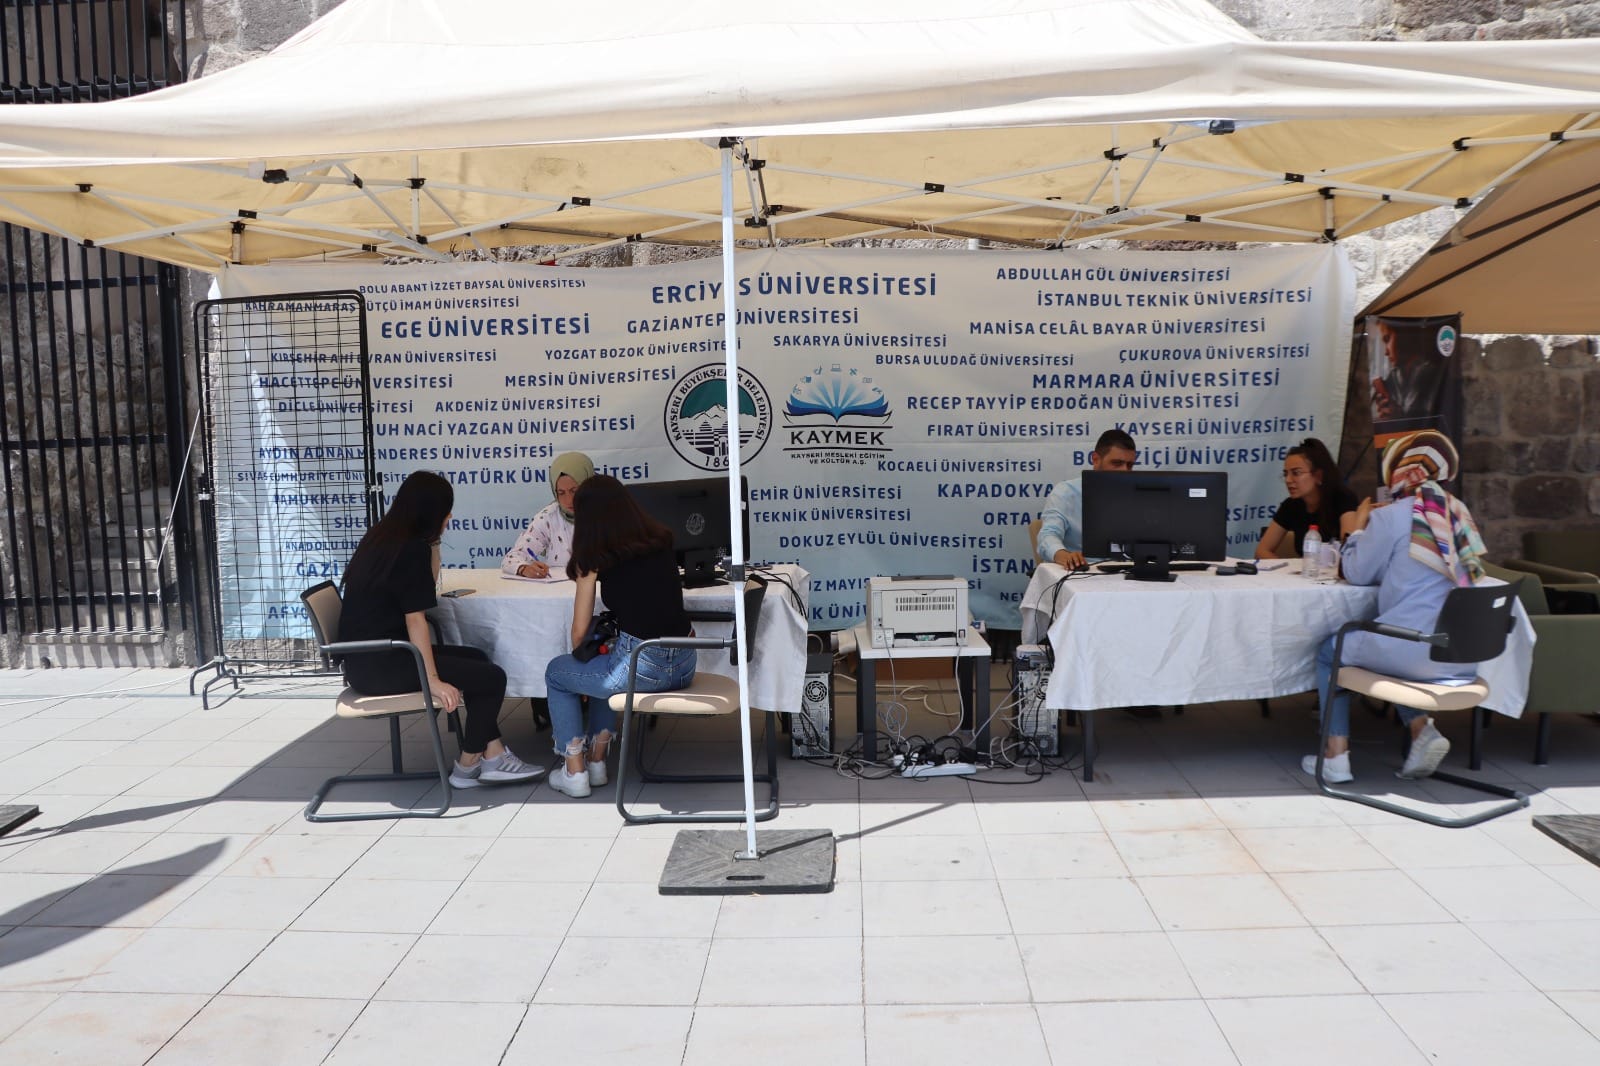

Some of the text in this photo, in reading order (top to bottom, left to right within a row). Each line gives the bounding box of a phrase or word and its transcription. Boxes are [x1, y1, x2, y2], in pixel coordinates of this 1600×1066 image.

[997, 267, 1230, 282] ABDULLAH GÜL ÜNİVERSİTESİ
[359, 278, 586, 294] BOLU ABANT İZZET BAYSAL ÜNİVERSİTESİ
[652, 271, 936, 304] ERCİYS ÜNİVERSİTESİ
[366, 301, 397, 313] ÜTÇÜ
[400, 300, 431, 310] İMAM
[435, 296, 519, 309] ÜNİVERSİTESİ
[1037, 287, 1312, 306] İSTANBUL TEKNİK ÜNİVERSİTESİ
[382, 313, 590, 338] EGE ÜNİVERSİTESİ
[627, 312, 726, 334] GAZİANTEP
[970, 318, 1266, 335] MANİSA CELÂL BAYAR ÜNİVERSİTESİ
[773, 332, 947, 347] SAKARYA ÜNİVERSİTESİ
[405, 349, 497, 363] ÜNİVERSİTESİ
[545, 337, 741, 361] YOZGAT BOZOK ÜNİVERSİTEİ
[1119, 344, 1310, 363] ÇUKUROVA ÜNİVERSİTESİ
[876, 353, 1074, 366] BURSA ULUDAĞ ÜNİVERSİTESİ
[260, 374, 453, 388] HACETTEPE ÜNVERSİTESİ
[505, 365, 676, 387] MERSİN ÜNİVERSİTESİ
[680, 368, 743, 395] BÜYÜKŞER
[1032, 368, 1280, 388] MARMARA ÜNİVERSİTESİ
[435, 395, 600, 412] AKDENİZ ÜNİVERSİTESİ
[907, 392, 1239, 410] RECEP TAYYİP ERDOĞAN ÜNİVERSİTESİ
[373, 415, 635, 436] UH NACİ YAZGAN ÜNİVERSİTESİ
[927, 421, 1090, 436] FIRAT ÜNİVERSİTESİ
[1198, 415, 1314, 434] ÜNİVERSİTESİ
[791, 431, 884, 445] KAYMEK
[260, 443, 553, 460] AYDIN ADNAN MNDERES ÜNİVERSİTESİ
[1175, 444, 1287, 466] ÜNİVERSİTE
[705, 456, 729, 467] 186
[877, 458, 1041, 472] KOCAELİ ÜNİVERSİTESİ
[793, 484, 901, 500] ÜNİVERSİTESİ
[937, 483, 1054, 498] KAPADOKYA
[754, 507, 911, 522] TEKNİK ÜNİVERSİTESİ
[983, 512, 1031, 526] ORTA
[780, 531, 1003, 549] DOKUZ EYLÜL ÜNİVERSİTESİ
[296, 560, 338, 577] GAZİ
[972, 555, 1034, 574] İSTAN
